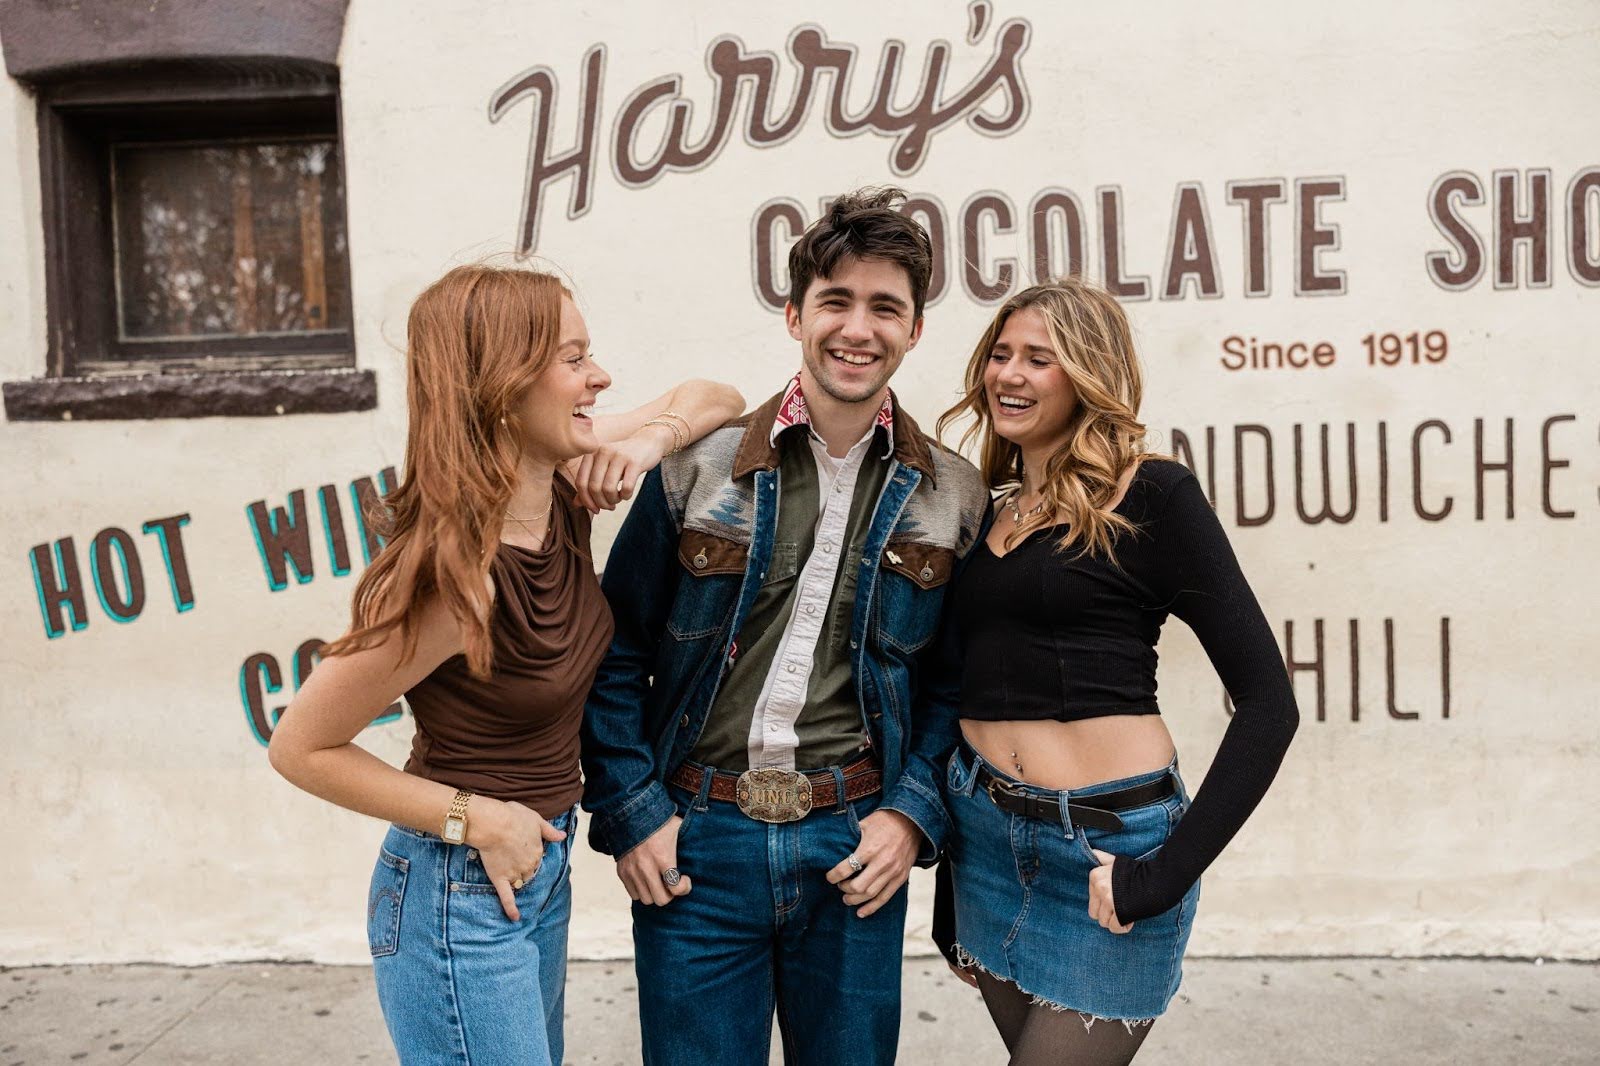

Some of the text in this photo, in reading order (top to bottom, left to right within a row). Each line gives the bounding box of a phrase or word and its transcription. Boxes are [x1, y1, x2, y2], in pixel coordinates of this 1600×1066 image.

[489, 0, 1031, 262] Harry's
[751, 165, 1600, 314] COCOLATE SHO
[1221, 330, 1448, 371] Since 1919
[1172, 414, 1600, 528] NDWICHE
[29, 512, 195, 639] HOT
[1223, 616, 1451, 722] HILI
